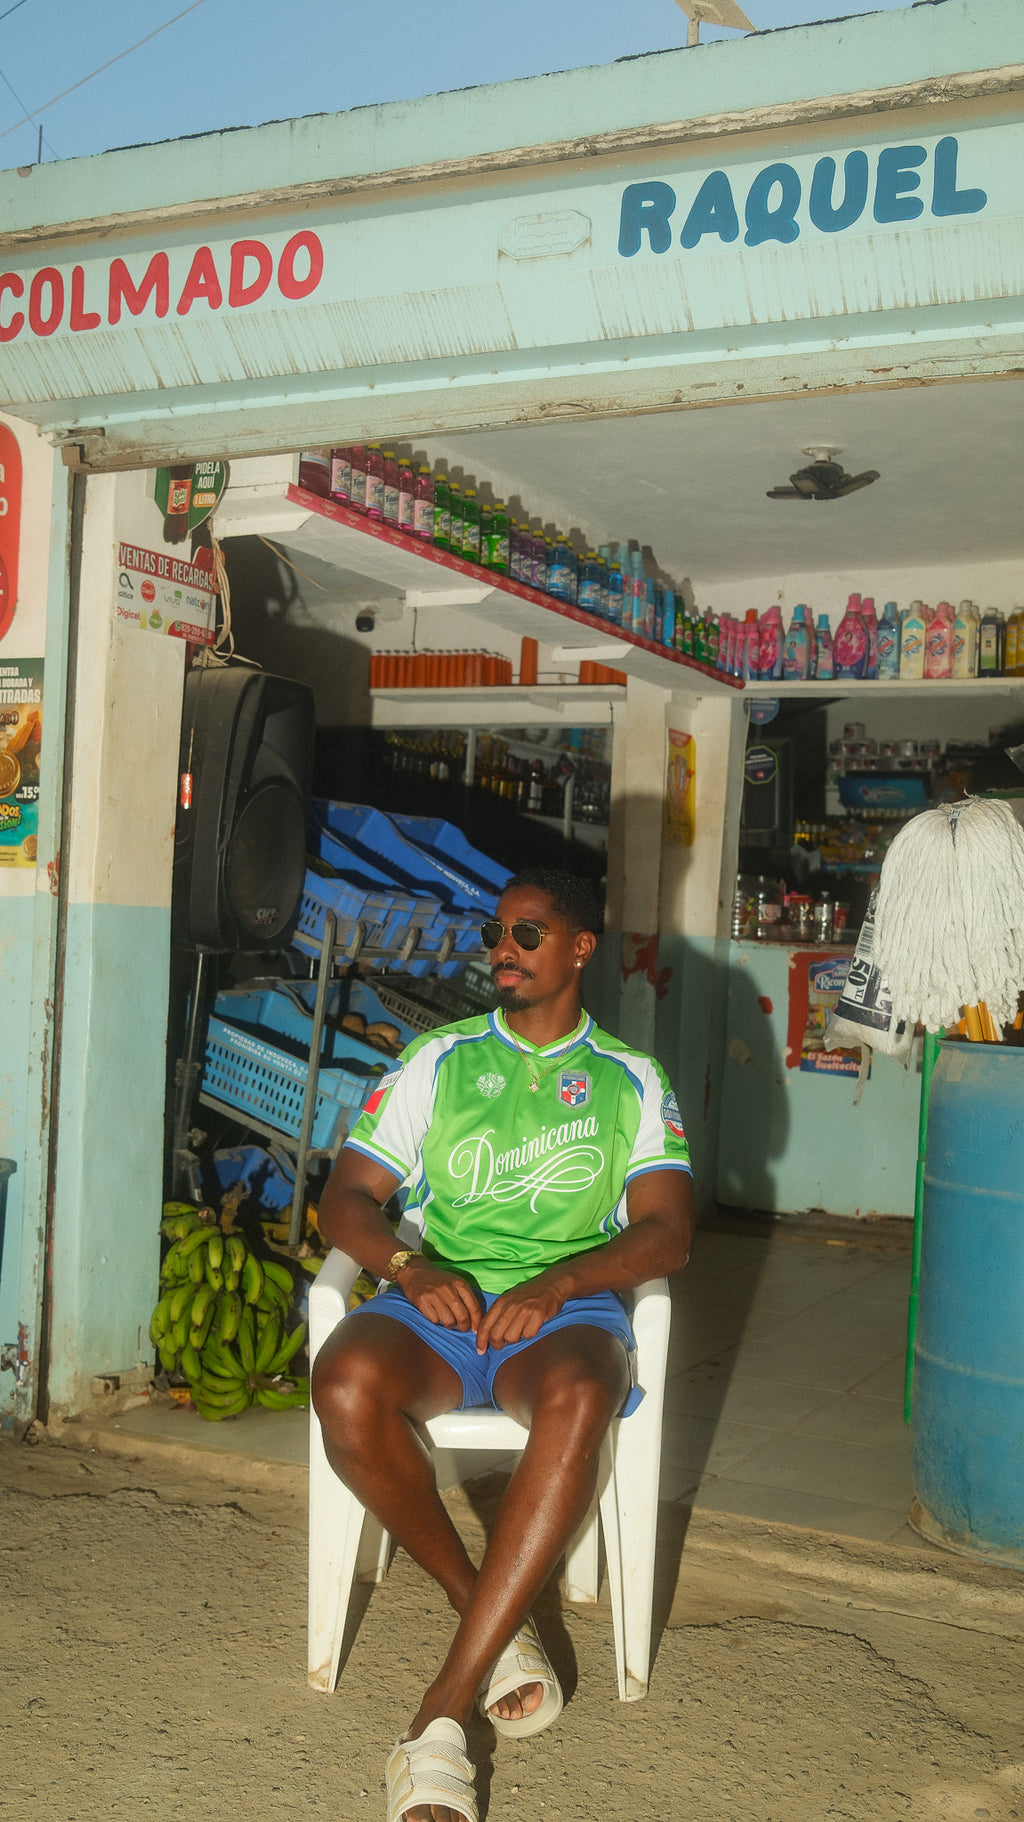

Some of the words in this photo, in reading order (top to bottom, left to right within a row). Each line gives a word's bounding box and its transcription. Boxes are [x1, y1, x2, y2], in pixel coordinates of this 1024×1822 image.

[617, 136, 988, 258] RAQUEL
[0, 230, 324, 342] COLMADO
[197, 474, 216, 489] AQUÍ
[120, 545, 156, 573] VENTAS
[158, 556, 171, 577] DE
[171, 561, 214, 591] RECARGAS
[28, 678, 34, 688] Y
[848, 956, 871, 987] 50
[854, 987, 865, 1000] XL
[223, 1027, 256, 1047] PROPIEDAD
[256, 1044, 265, 1052] DE
[229, 1037, 262, 1057] PROHIBIDA
[262, 1053, 272, 1061] SU
[272, 1058, 293, 1072] VENTA
[807, 1052, 817, 1061] El
[817, 1052, 844, 1063] Sazón
[448, 1116, 604, 1213] Dominicana
